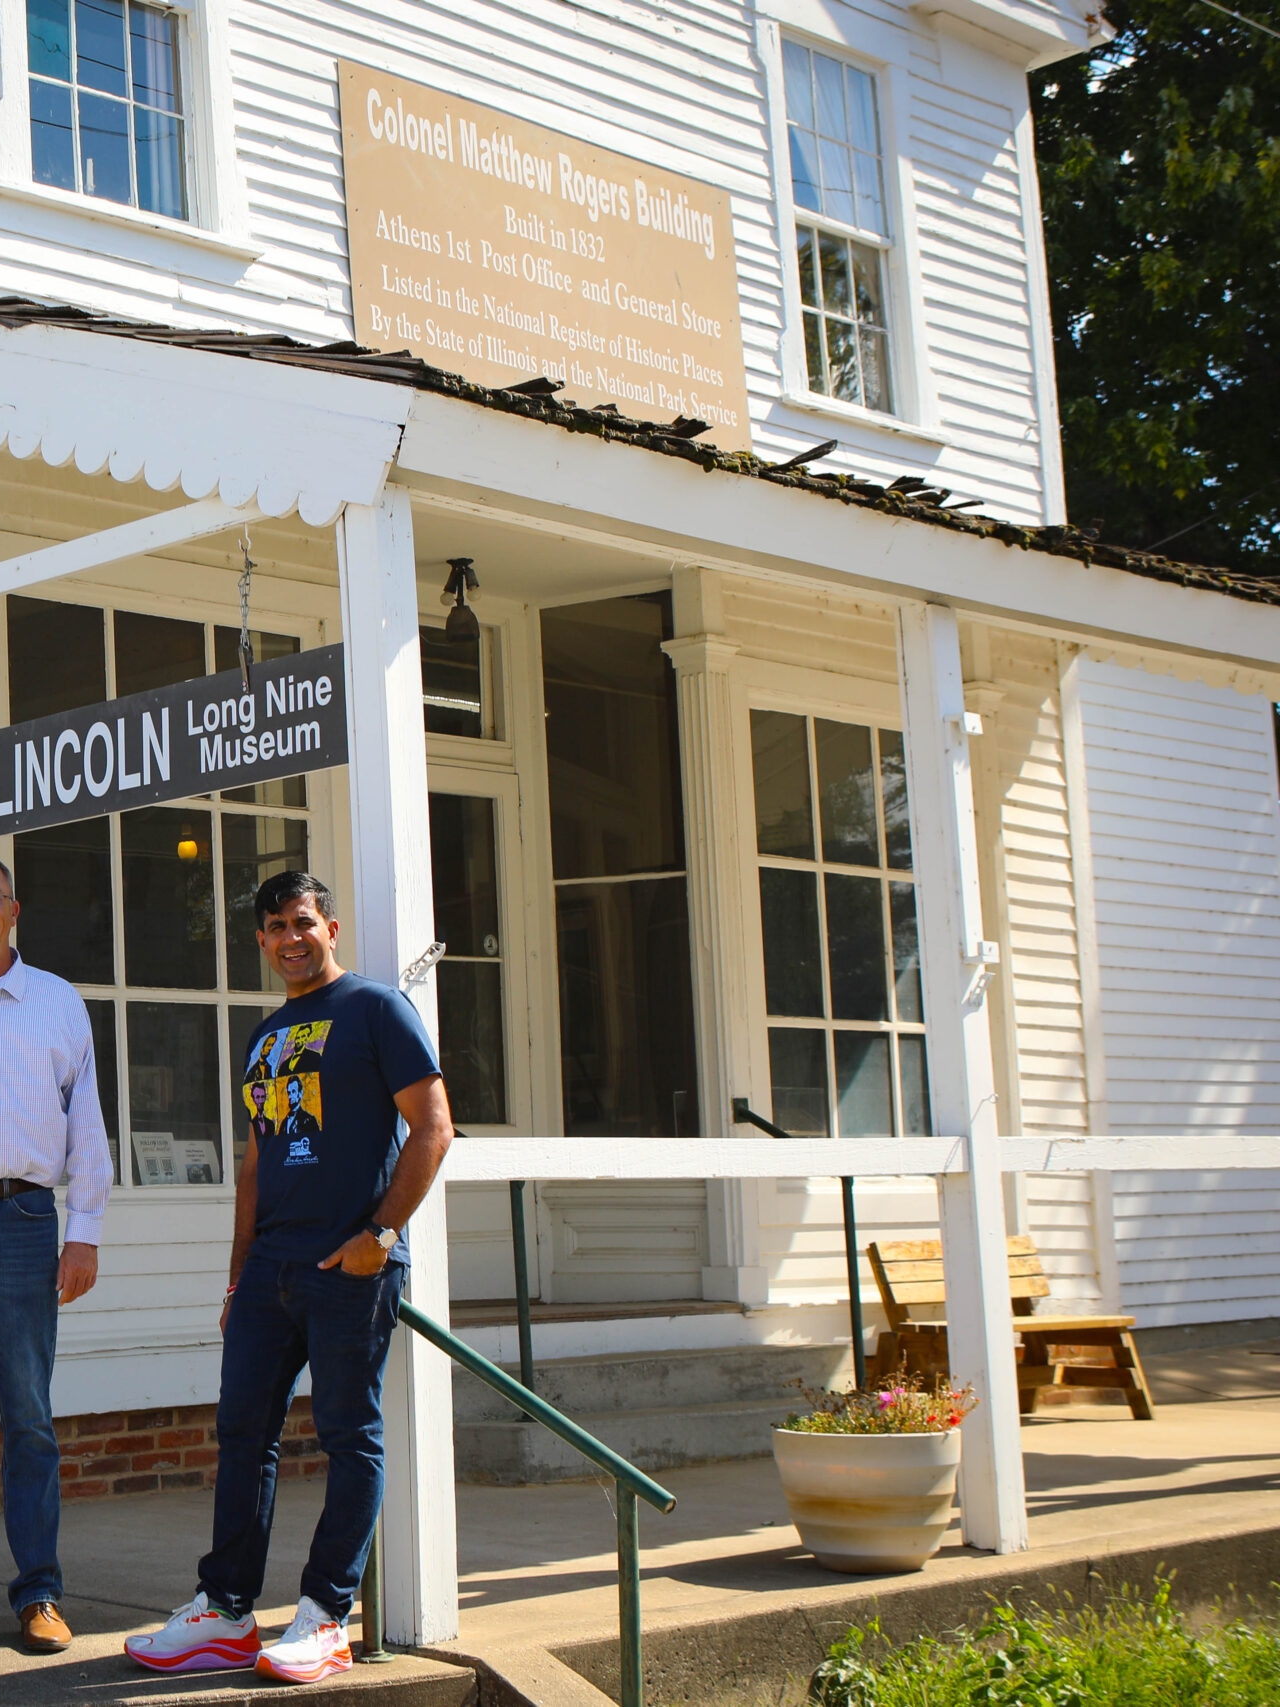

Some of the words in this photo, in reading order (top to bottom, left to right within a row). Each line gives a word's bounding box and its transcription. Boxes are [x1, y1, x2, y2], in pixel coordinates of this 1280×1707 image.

[367, 88, 454, 163] Colonel
[459, 118, 552, 195] Matthew
[558, 152, 631, 223] Rogers
[634, 178, 715, 261] Building
[504, 204, 547, 244] Built
[550, 219, 567, 252] in
[570, 227, 606, 263] 1832
[375, 209, 441, 255] Athens
[446, 231, 472, 264] 1st
[480, 239, 518, 278] Post
[522, 253, 573, 294] Office
[581, 278, 611, 306] and
[614, 282, 678, 327] General
[681, 302, 722, 339] Store
[381, 264, 433, 304] Listed
[436, 279, 452, 310] in
[456, 288, 480, 317] the
[483, 294, 546, 337] National
[549, 313, 606, 354] Register
[609, 334, 623, 359] of
[625, 335, 679, 375] Historic
[681, 352, 724, 387] Places
[370, 304, 392, 341] By
[396, 312, 422, 342] the
[425, 318, 465, 353] State
[468, 333, 484, 359] of
[486, 335, 537, 374] Illinois
[541, 356, 568, 382] and
[570, 361, 593, 389] the
[596, 366, 655, 406] National
[657, 383, 688, 415] Park
[691, 392, 737, 428] Service
[187, 692, 256, 738] Long
[265, 675, 332, 717] Nine
[200, 721, 322, 774] Museum
